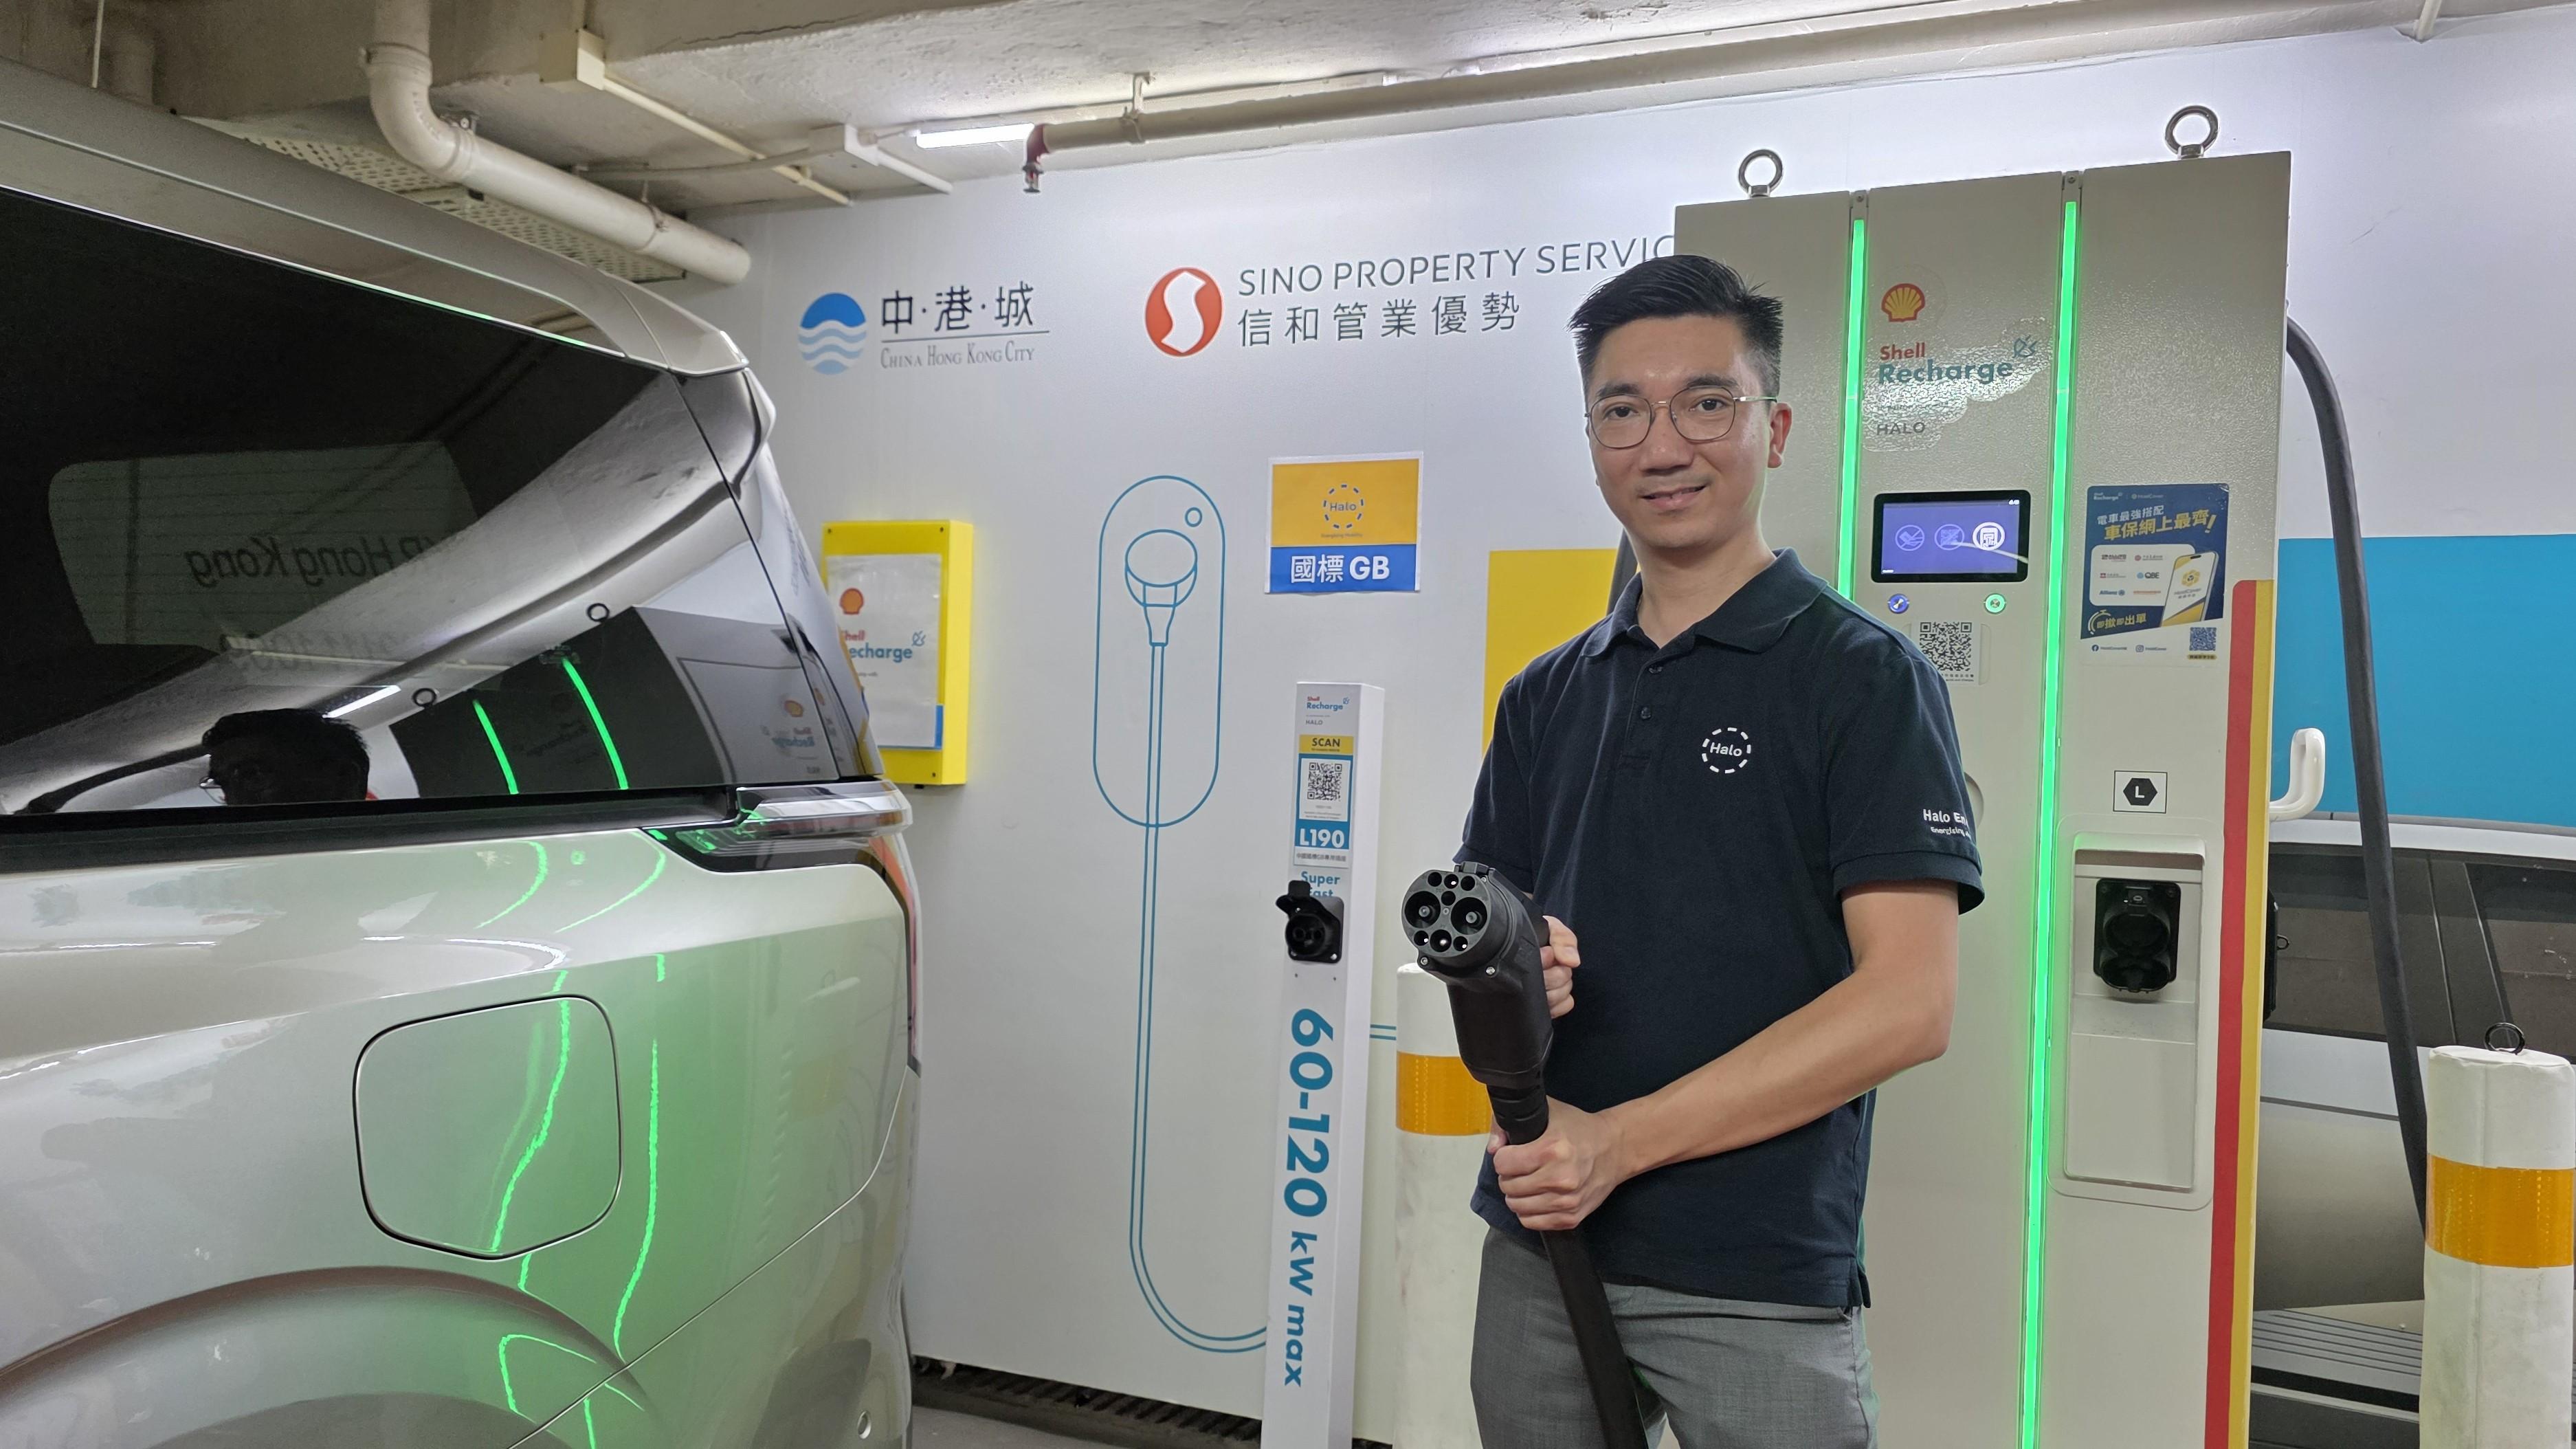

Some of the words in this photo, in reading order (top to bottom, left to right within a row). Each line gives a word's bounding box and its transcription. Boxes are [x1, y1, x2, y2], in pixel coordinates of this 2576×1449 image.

[1238, 264, 1322, 297] SINO
[1333, 247, 1526, 290] PROPERTY
[1237, 291, 1520, 347] 信和管業優勢
[1880, 342, 1926, 361] Shell
[1878, 358, 2013, 385] Recharge
[1876, 421, 1925, 435] HALO
[1330, 501, 1357, 511] Halo
[2097, 505, 2164, 526] 電車最強搭配
[2103, 509, 2217, 541] 車保網上最齊!
[1290, 554, 1344, 584] 國標
[1349, 555, 1390, 581] GB
[842, 630, 865, 641] hell
[848, 641, 913, 663] echarge
[1307, 701, 1344, 711] Recharge
[1311, 737, 1340, 747] SCAN
[1709, 742, 1742, 757] Halo
[2135, 786, 2145, 799] L
[1922, 808, 1951, 823] Halo
[1953, 812, 1969, 828] En
[1299, 828, 1345, 848] L190
[1300, 870, 1340, 887] Super
[1283, 1008, 1334, 1217] 60-120
[1288, 1230, 1318, 1296] kW
[1284, 1304, 1305, 1387] max
